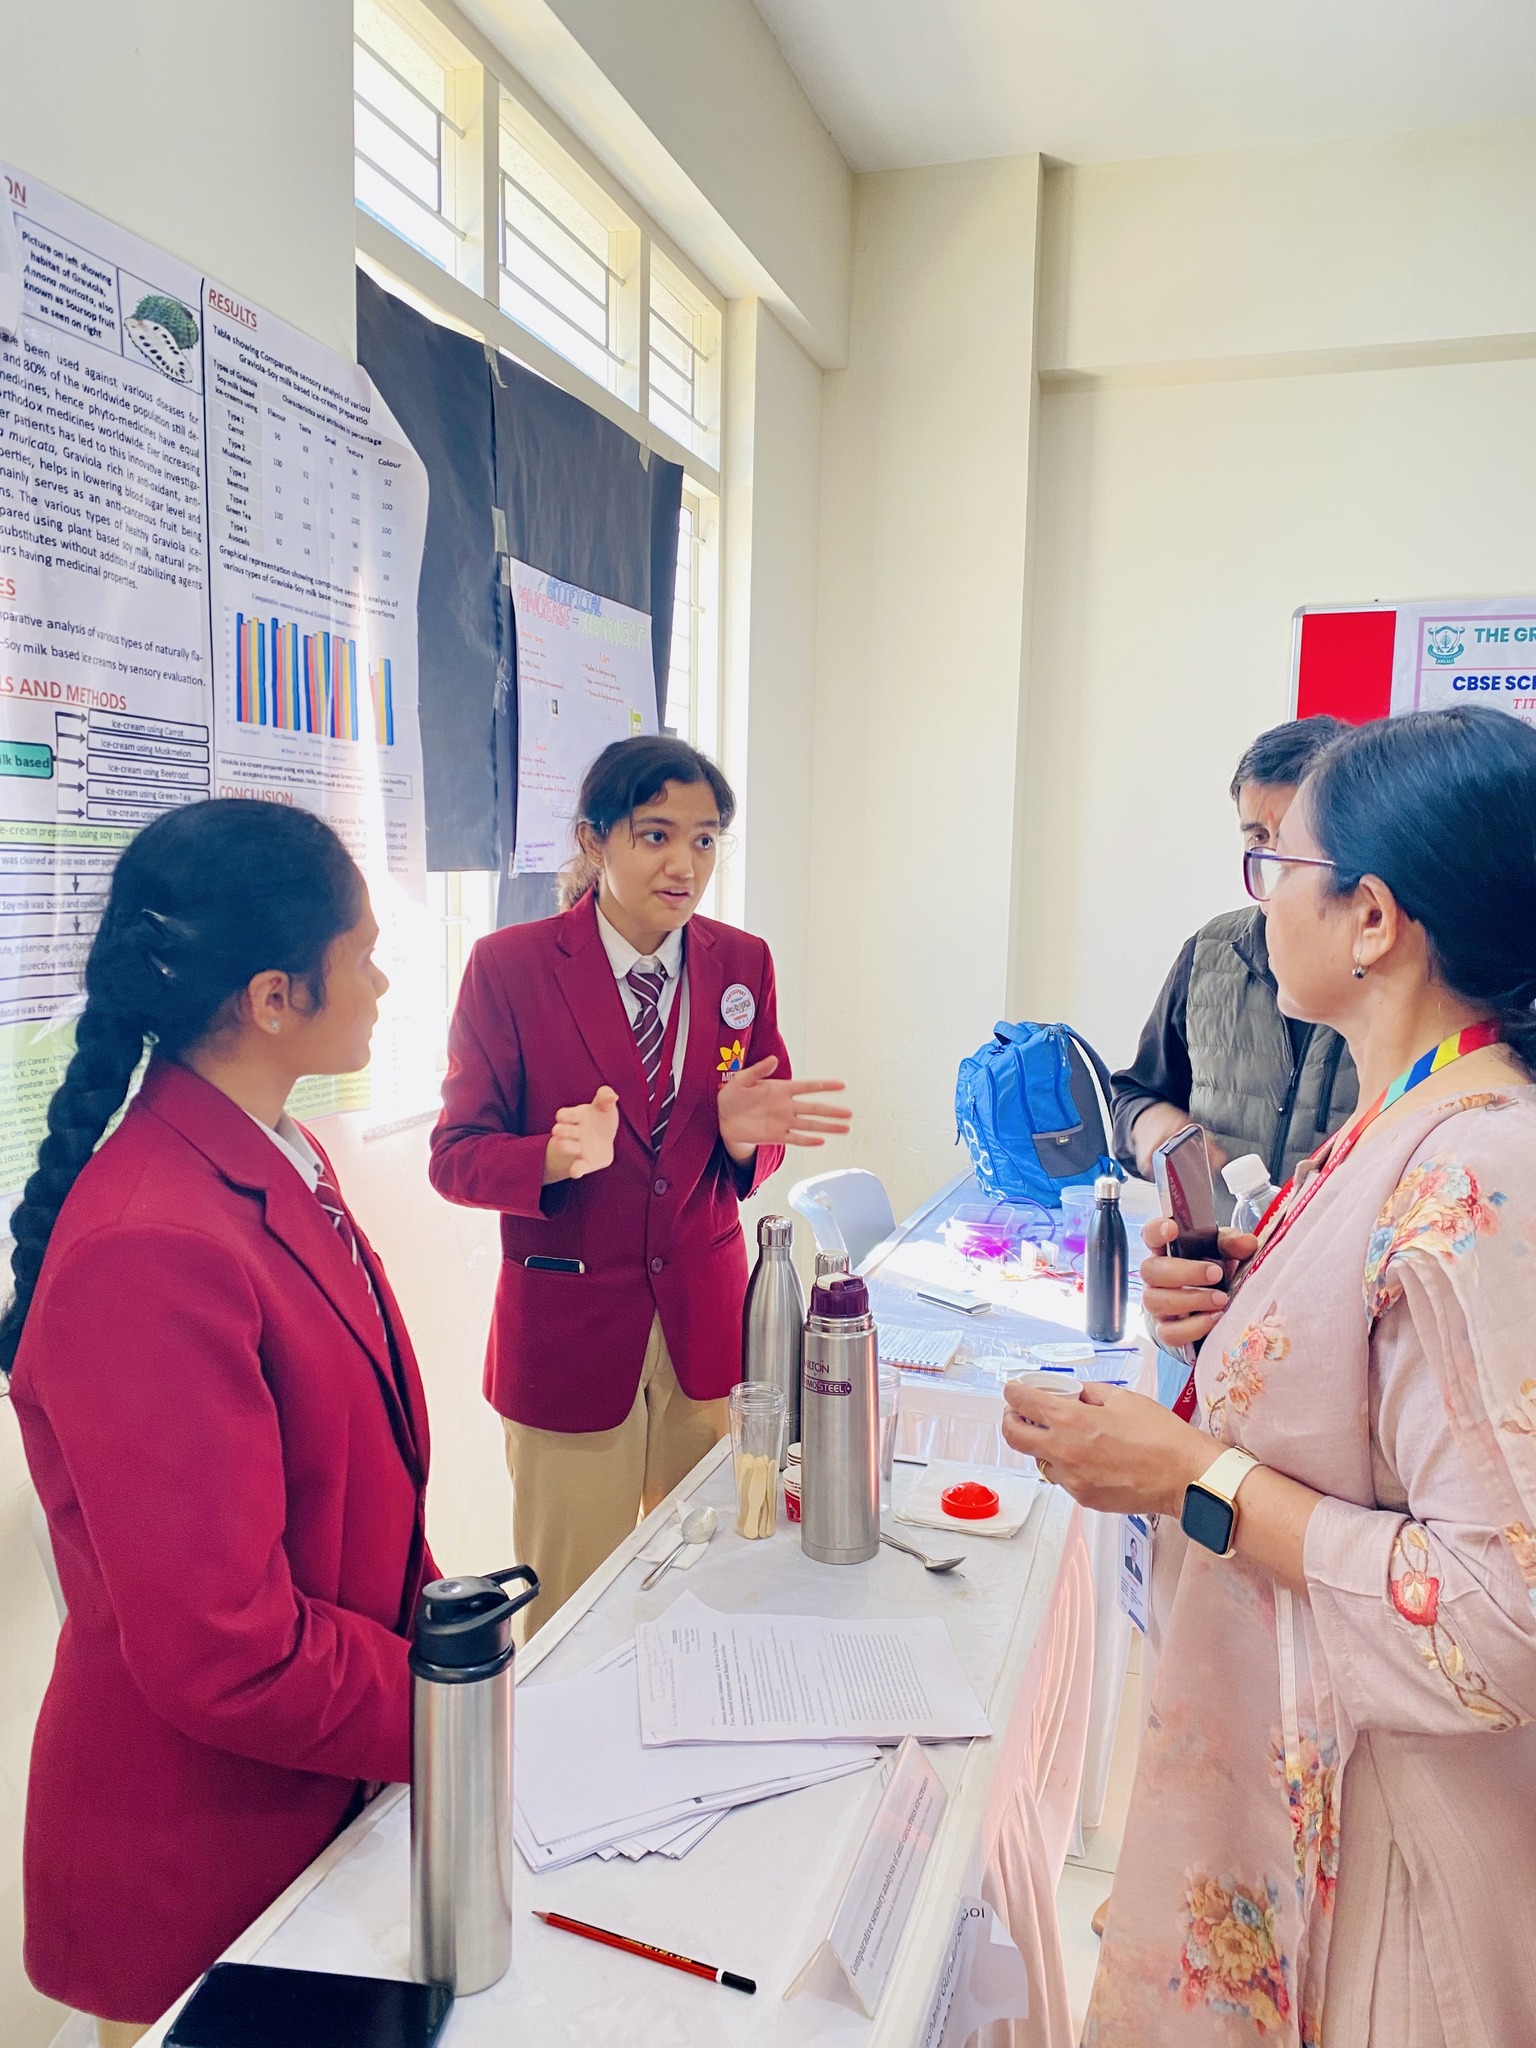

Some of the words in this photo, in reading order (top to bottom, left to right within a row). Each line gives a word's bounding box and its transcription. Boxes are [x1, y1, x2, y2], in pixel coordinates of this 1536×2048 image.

[22, 231, 52, 254] Picture
[53, 249, 64, 261] on
[65, 253, 78, 268] left
[81, 262, 112, 286] showing
[30, 251, 60, 274] habitat
[24, 265, 57, 287] Annona
[59, 281, 96, 308] muricata,
[98, 301, 114, 314] also
[24, 279, 54, 301] known
[65, 299, 97, 322] Soursop
[98, 314, 115, 330] fruit
[208, 289, 257, 328] RESULTS
[51, 309, 70, 324] seen
[72, 318, 82, 329] on
[24, 340, 51, 360] been
[57, 355, 79, 371] used
[85, 366, 118, 388] against
[122, 382, 153, 402] various
[156, 398, 184, 418] diseases
[189, 412, 199, 425] for
[213, 325, 231, 342] Table
[232, 336, 259, 359] showing
[260, 350, 299, 378] Comparative
[299, 372, 321, 392] sensory
[322, 384, 344, 402] analysis
[3, 352, 21, 367] and
[24, 360, 47, 377] 80%
[50, 371, 61, 381] of
[63, 374, 80, 389] the
[82, 383, 130, 410] worldwide
[133, 404, 170, 429] population
[171, 422, 185, 436] still
[279, 374, 293, 388] milk
[293, 382, 310, 397] based
[55, 388, 84, 409] hence
[88, 404, 156, 440] phyto-medicines
[159, 432, 176, 449] have
[227, 410, 240, 423] Type
[228, 423, 244, 437] Carrot
[9, 430, 58, 456] muricata,
[63, 446, 102, 469] Graviola
[107, 462, 123, 477] rich
[126, 468, 135, 482] in
[14, 413, 56, 436] patients
[59, 426, 76, 442] has
[78, 433, 94, 449] led
[96, 441, 106, 453] to
[109, 445, 126, 461] this
[128, 451, 162, 477] innovative
[46, 406, 95, 432] medicines
[97, 423, 145, 451] worldwide.
[162, 453, 201, 478] increasing
[222, 447, 252, 466] Muskmelon
[378, 458, 402, 469] Colour
[383, 478, 392, 487] 92
[35, 477, 69, 495] serves
[73, 489, 84, 499] as
[89, 494, 101, 504] an
[106, 499, 156, 525] anti-cancerous
[160, 519, 177, 533] fruit
[181, 525, 202, 542] being
[40, 457, 67, 476] helps
[71, 467, 80, 480] in
[84, 470, 122, 496] lowering
[125, 486, 143, 503] blood
[144, 497, 164, 511] sugar
[166, 503, 185, 518] level
[188, 513, 201, 524] and
[19, 489, 38, 505] The
[44, 499, 81, 517] various
[86, 509, 111, 527] types
[114, 520, 122, 531] of
[125, 524, 149, 542] healthy
[152, 534, 185, 552] Graviola
[33, 516, 63, 532] using
[68, 523, 91, 538] plant
[96, 528, 120, 547] based
[122, 541, 133, 554] soy
[155, 553, 185, 569] natural
[19, 546, 52, 567] having
[56, 558, 101, 577] medicinal
[103, 570, 138, 590] properties.
[60, 540, 97, 559] without
[99, 551, 128, 569] addition
[129, 561, 136, 571] of
[137, 564, 176, 585] stabilizing
[178, 576, 202, 590] agents
[219, 545, 248, 562] Graphical
[249, 556, 291, 576] representation
[291, 569, 314, 585] showing
[223, 562, 245, 575] various
[270, 576, 304, 595] Graviola-Soy
[305, 587, 317, 597] milk
[46, 618, 86, 636] analysis
[87, 626, 97, 637] of
[96, 629, 119, 645] various
[121, 636, 142, 650] types
[145, 640, 154, 651] of
[155, 644, 189, 661] naturally
[1474, 627, 1510, 643] THE
[23, 642, 47, 656] milk
[51, 645, 80, 661] based
[81, 652, 92, 664] ice
[92, 655, 117, 670] creams
[118, 662, 128, 674] by
[129, 665, 161, 681] sensory
[162, 671, 206, 687] evaluation.
[1452, 675, 1501, 691] CBSE
[20, 678, 62, 699] AND
[66, 684, 127, 710] METHODS
[112, 719, 146, 732] Ice-cream
[147, 725, 164, 737] using
[164, 727, 184, 738] Carrot
[15, 755, 50, 769] based
[101, 739, 135, 752] Ice-cream
[136, 744, 153, 756] using
[154, 745, 192, 758] Muskmelon
[108, 764, 142, 776] Ice-cream
[142, 767, 159, 779] using
[160, 769, 189, 781] Beetroot
[105, 787, 138, 798] Ice-cream
[139, 790, 157, 801] using
[157, 789, 192, 803] Green-Tea
[106, 807, 140, 819] Ice-cream
[78, 828, 98, 841] using
[99, 831, 112, 841] soy
[1328, 1138, 1351, 1171] PUNE
[850, 1922, 874, 1977] Comparative
[870, 1895, 886, 1925] sensory
